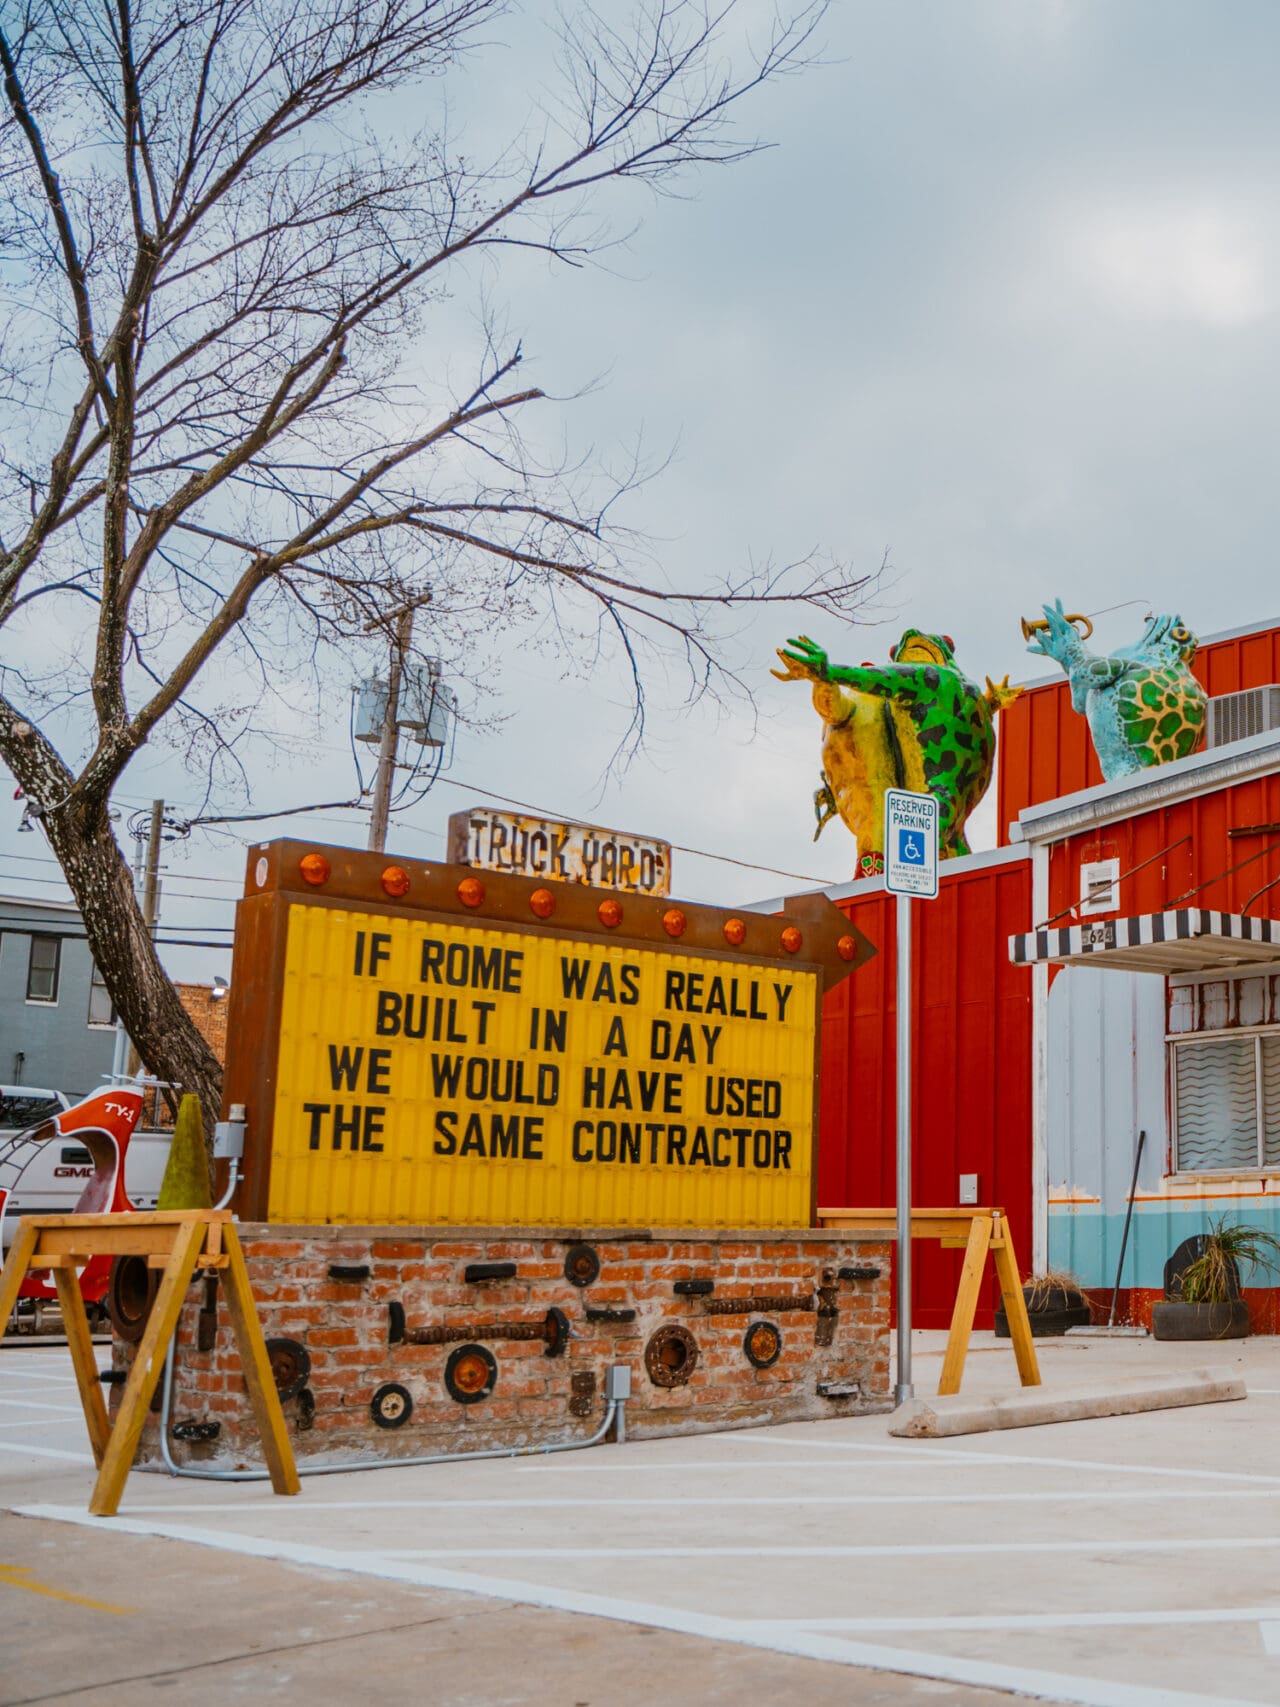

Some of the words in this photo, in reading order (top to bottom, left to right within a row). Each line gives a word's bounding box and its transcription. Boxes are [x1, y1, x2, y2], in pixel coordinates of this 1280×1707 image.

[891, 798, 933, 816] RESERVED
[893, 813, 931, 830] PARKING
[470, 819, 570, 877] TRUCK
[583, 839, 655, 892] YARD
[353, 931, 392, 976] IF
[420, 939, 525, 993] ROME
[561, 956, 640, 1005] WAS
[665, 970, 793, 1022] REALLY
[377, 990, 495, 1044] BUILT
[530, 1008, 567, 1053] IN
[604, 1015, 628, 1058] A
[651, 1021, 723, 1066] DAY
[104, 1102, 136, 1123] TY-1
[328, 1043, 391, 1095] WE
[431, 1053, 560, 1106] WOULD
[582, 1067, 682, 1114] HAVE
[705, 1076, 781, 1119] USED
[303, 1103, 386, 1152] THE
[433, 1111, 544, 1160] SAME
[571, 1120, 793, 1170] CONTRACTOR
